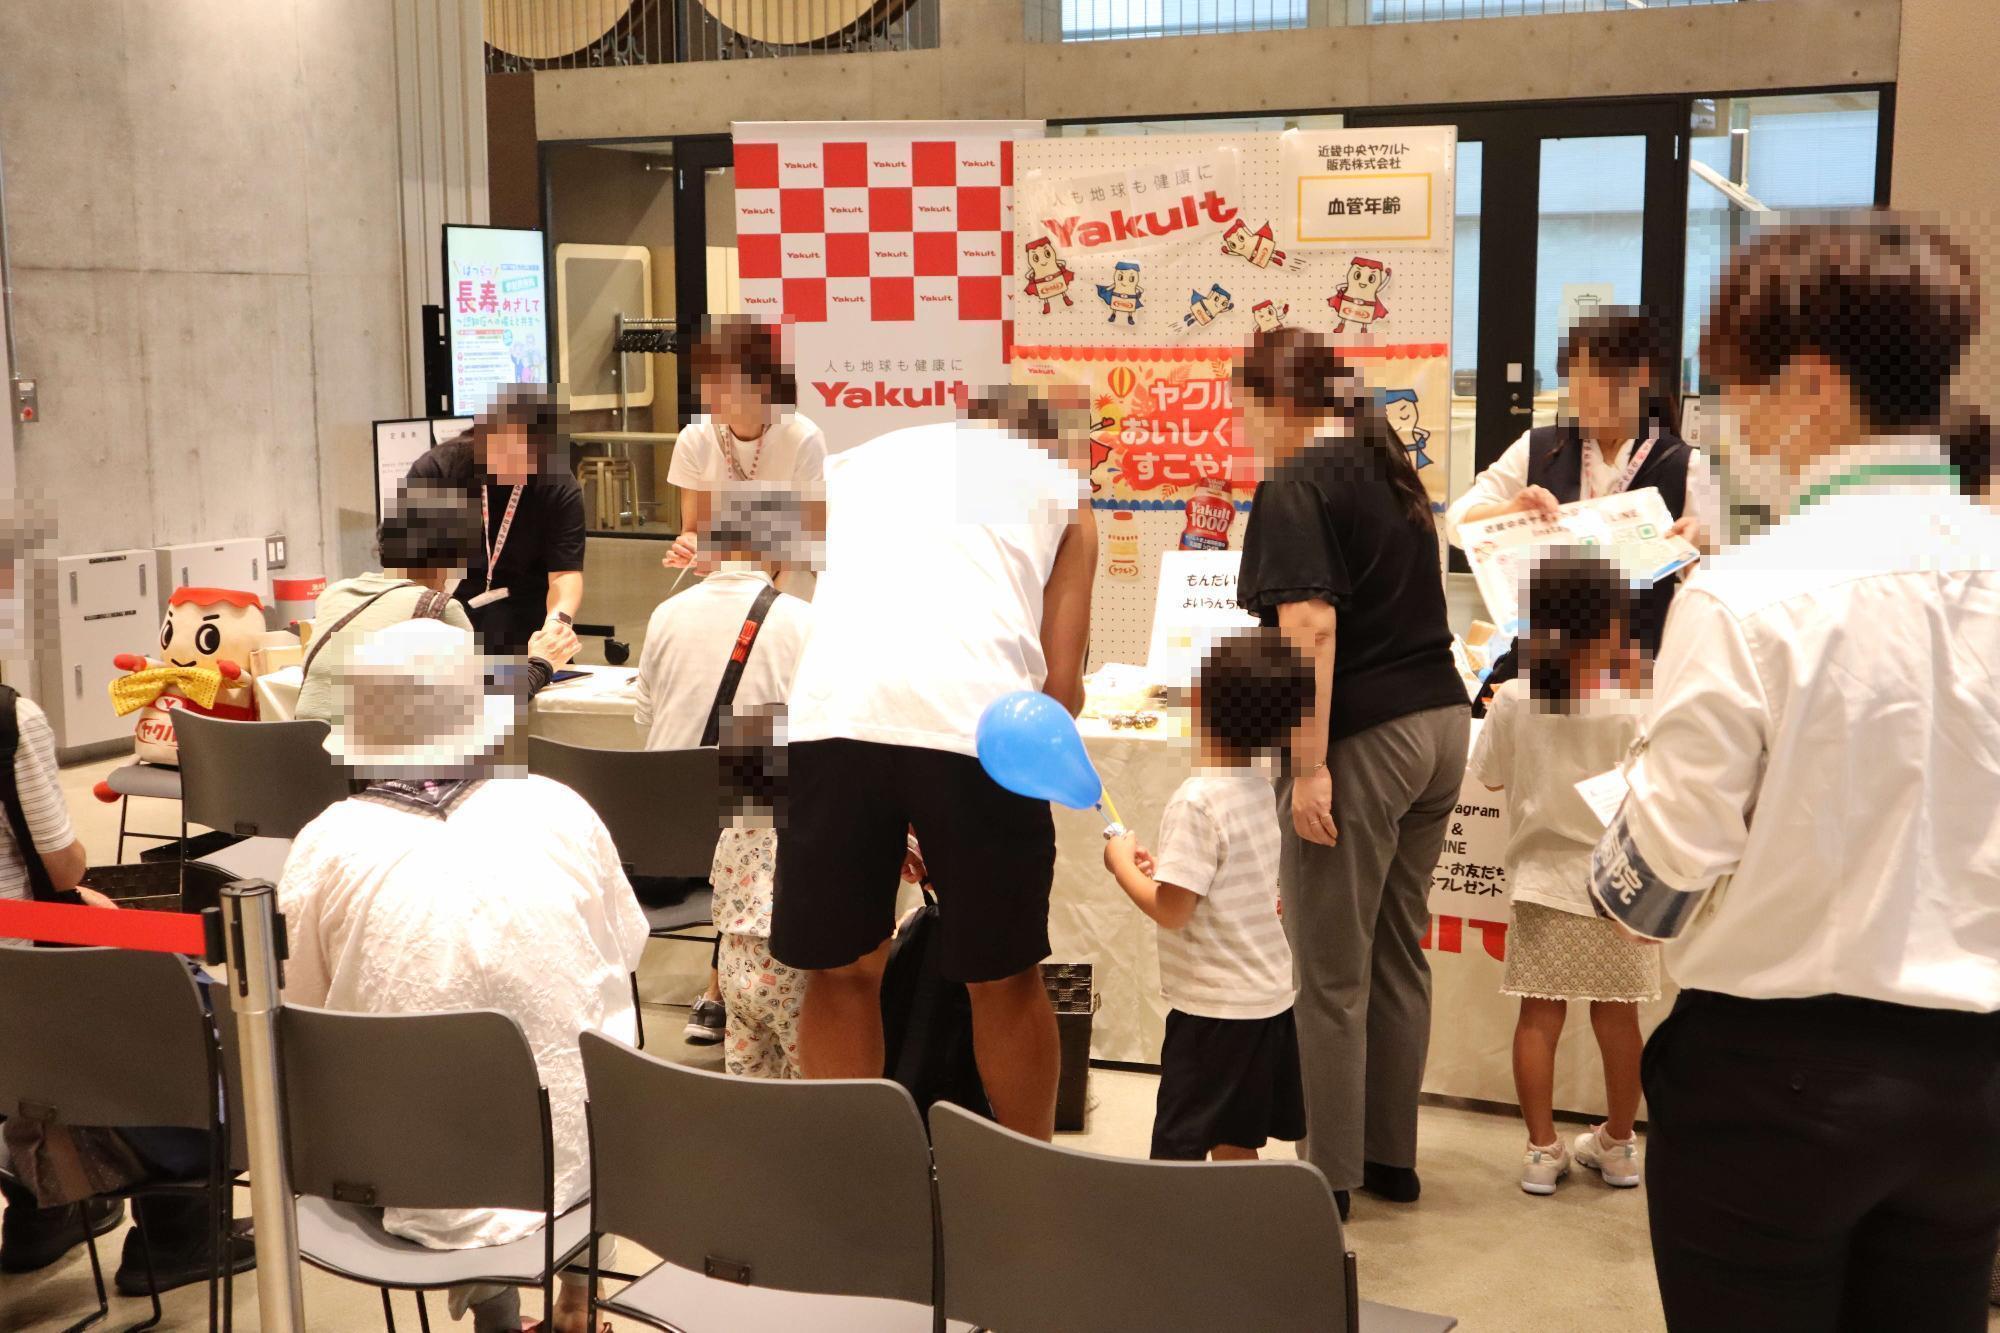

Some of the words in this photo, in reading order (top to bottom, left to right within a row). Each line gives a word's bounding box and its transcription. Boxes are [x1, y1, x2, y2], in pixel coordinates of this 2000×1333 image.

[1317, 143, 1410, 158] 近畿中央ヤクルト
[784, 161, 819, 169] Yakult
[873, 160, 908, 168] Yakult
[961, 159, 996, 167] Yakult
[1326, 156, 1402, 172] 販売株式会社
[741, 208, 776, 216] Yakult
[830, 206, 864, 214] Yakult
[918, 205, 952, 213] Yakult
[1327, 196, 1401, 216] 血管年齢
[1040, 190, 1239, 248] Yakult
[786, 251, 821, 260] Yakult
[875, 250, 909, 258] Yakult
[963, 249, 997, 257] Yakult
[744, 296, 779, 304] Yakult
[832, 295, 867, 303] Yakult
[919, 294, 953, 302] Yakult
[825, 359, 963, 373] 人も地球も健康に
[1120, 416, 1231, 448] おいしく
[1188, 513, 1229, 533] 1000
[1186, 574, 1237, 587] もんだい
[1451, 822, 1464, 836] &
